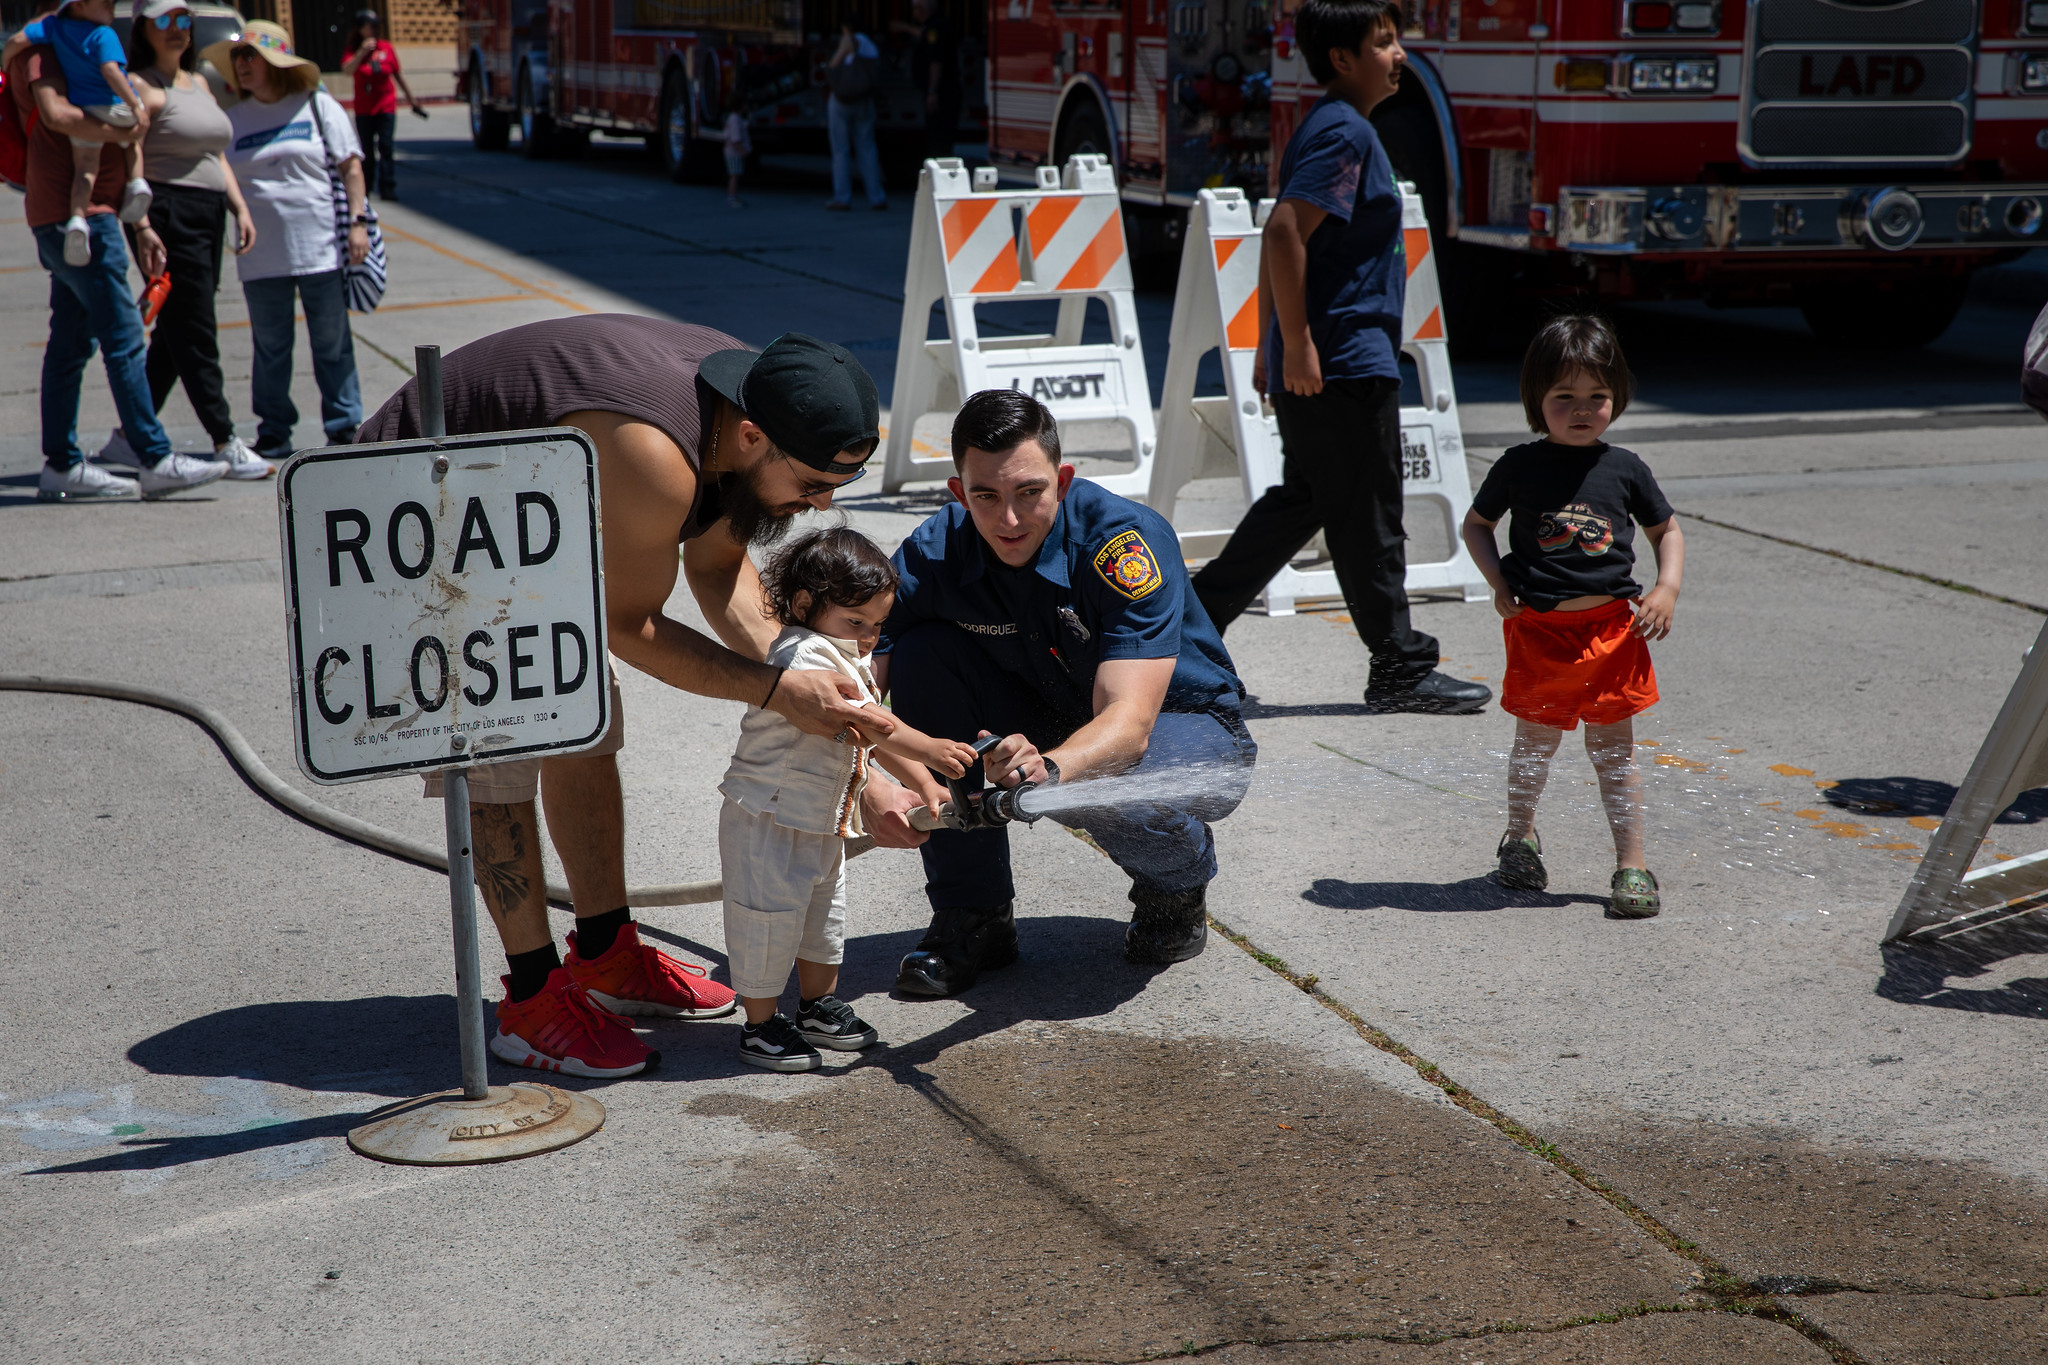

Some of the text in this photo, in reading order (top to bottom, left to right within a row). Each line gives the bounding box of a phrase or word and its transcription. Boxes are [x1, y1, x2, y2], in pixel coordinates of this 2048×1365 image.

[1800, 56, 1924, 94] LAFD
[1404, 444, 1427, 459] RKS
[1402, 460, 1431, 479] CES
[325, 491, 561, 587] ROAD
[1097, 533, 1137, 566] LOS ANGELES
[1111, 546, 1127, 559] FIRE
[1131, 576, 1160, 597] DEPARTMENT
[314, 621, 588, 725] CLOSED
[354, 736, 367, 746] SSC
[369, 733, 389, 745] 10/96
[397, 728, 431, 741] PROPERTY
[432, 726, 441, 736] OF
[443, 724, 455, 734] THE
[457, 722, 471, 732] CITY
[473, 720, 481, 730] OF
[483, 719, 496, 729] LOS
[497, 715, 525, 727] ANGELES
[456, 1123, 501, 1136] CITY
[513, 1114, 536, 1127] OF
